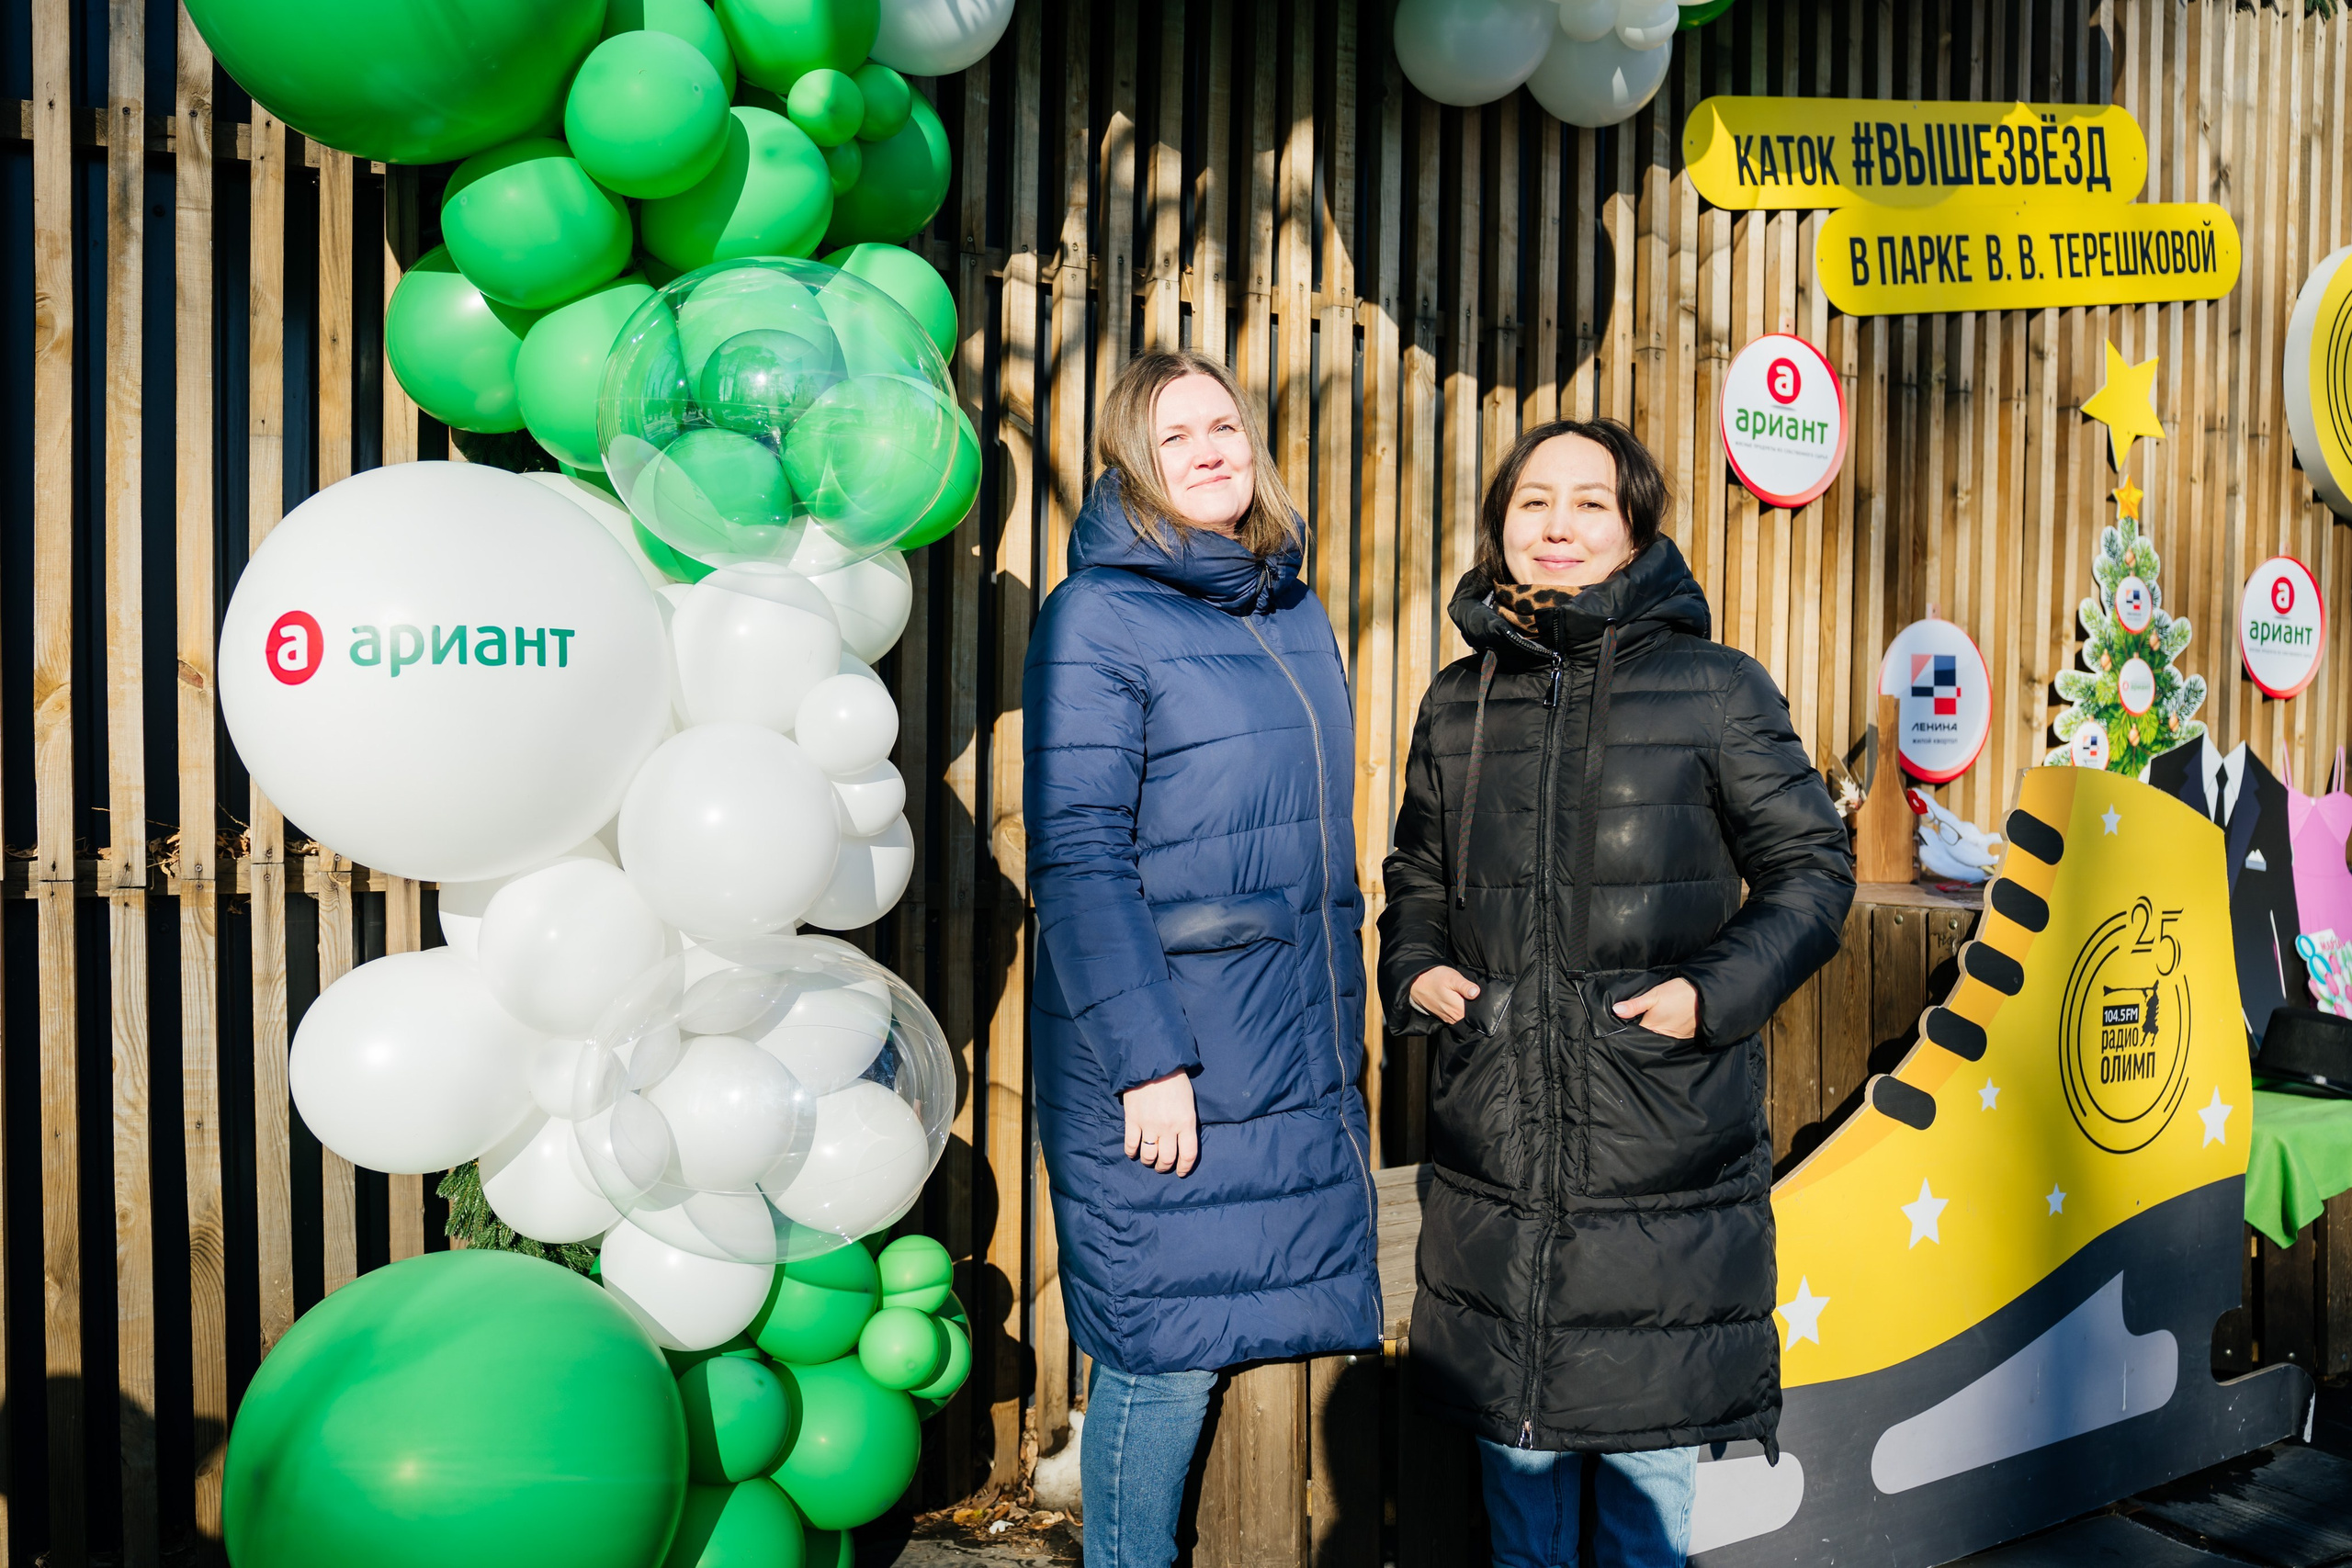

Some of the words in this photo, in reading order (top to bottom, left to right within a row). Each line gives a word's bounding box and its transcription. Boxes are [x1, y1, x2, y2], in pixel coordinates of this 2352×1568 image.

[1733, 134, 1841, 186] КАТОК
[1850, 113, 2112, 193] #ВЫШЕЗВЁЗД
[1849, 236, 1871, 287] В
[1877, 234, 1973, 287] ПАРКЕ
[1985, 234, 2012, 282] В.
[2018, 234, 2045, 281] В.
[2049, 220, 2218, 279] ТЕРЕШКОВОЙ
[1736, 408, 1829, 445] ариант
[348, 624, 576, 679] ариант
[2249, 621, 2313, 646] ариант
[1911, 722, 1958, 732] ЛЕНИНА
[2131, 896, 2184, 976] 25
[2101, 1027, 2139, 1055] радио
[2100, 1052, 2156, 1085] ОЛИМП
